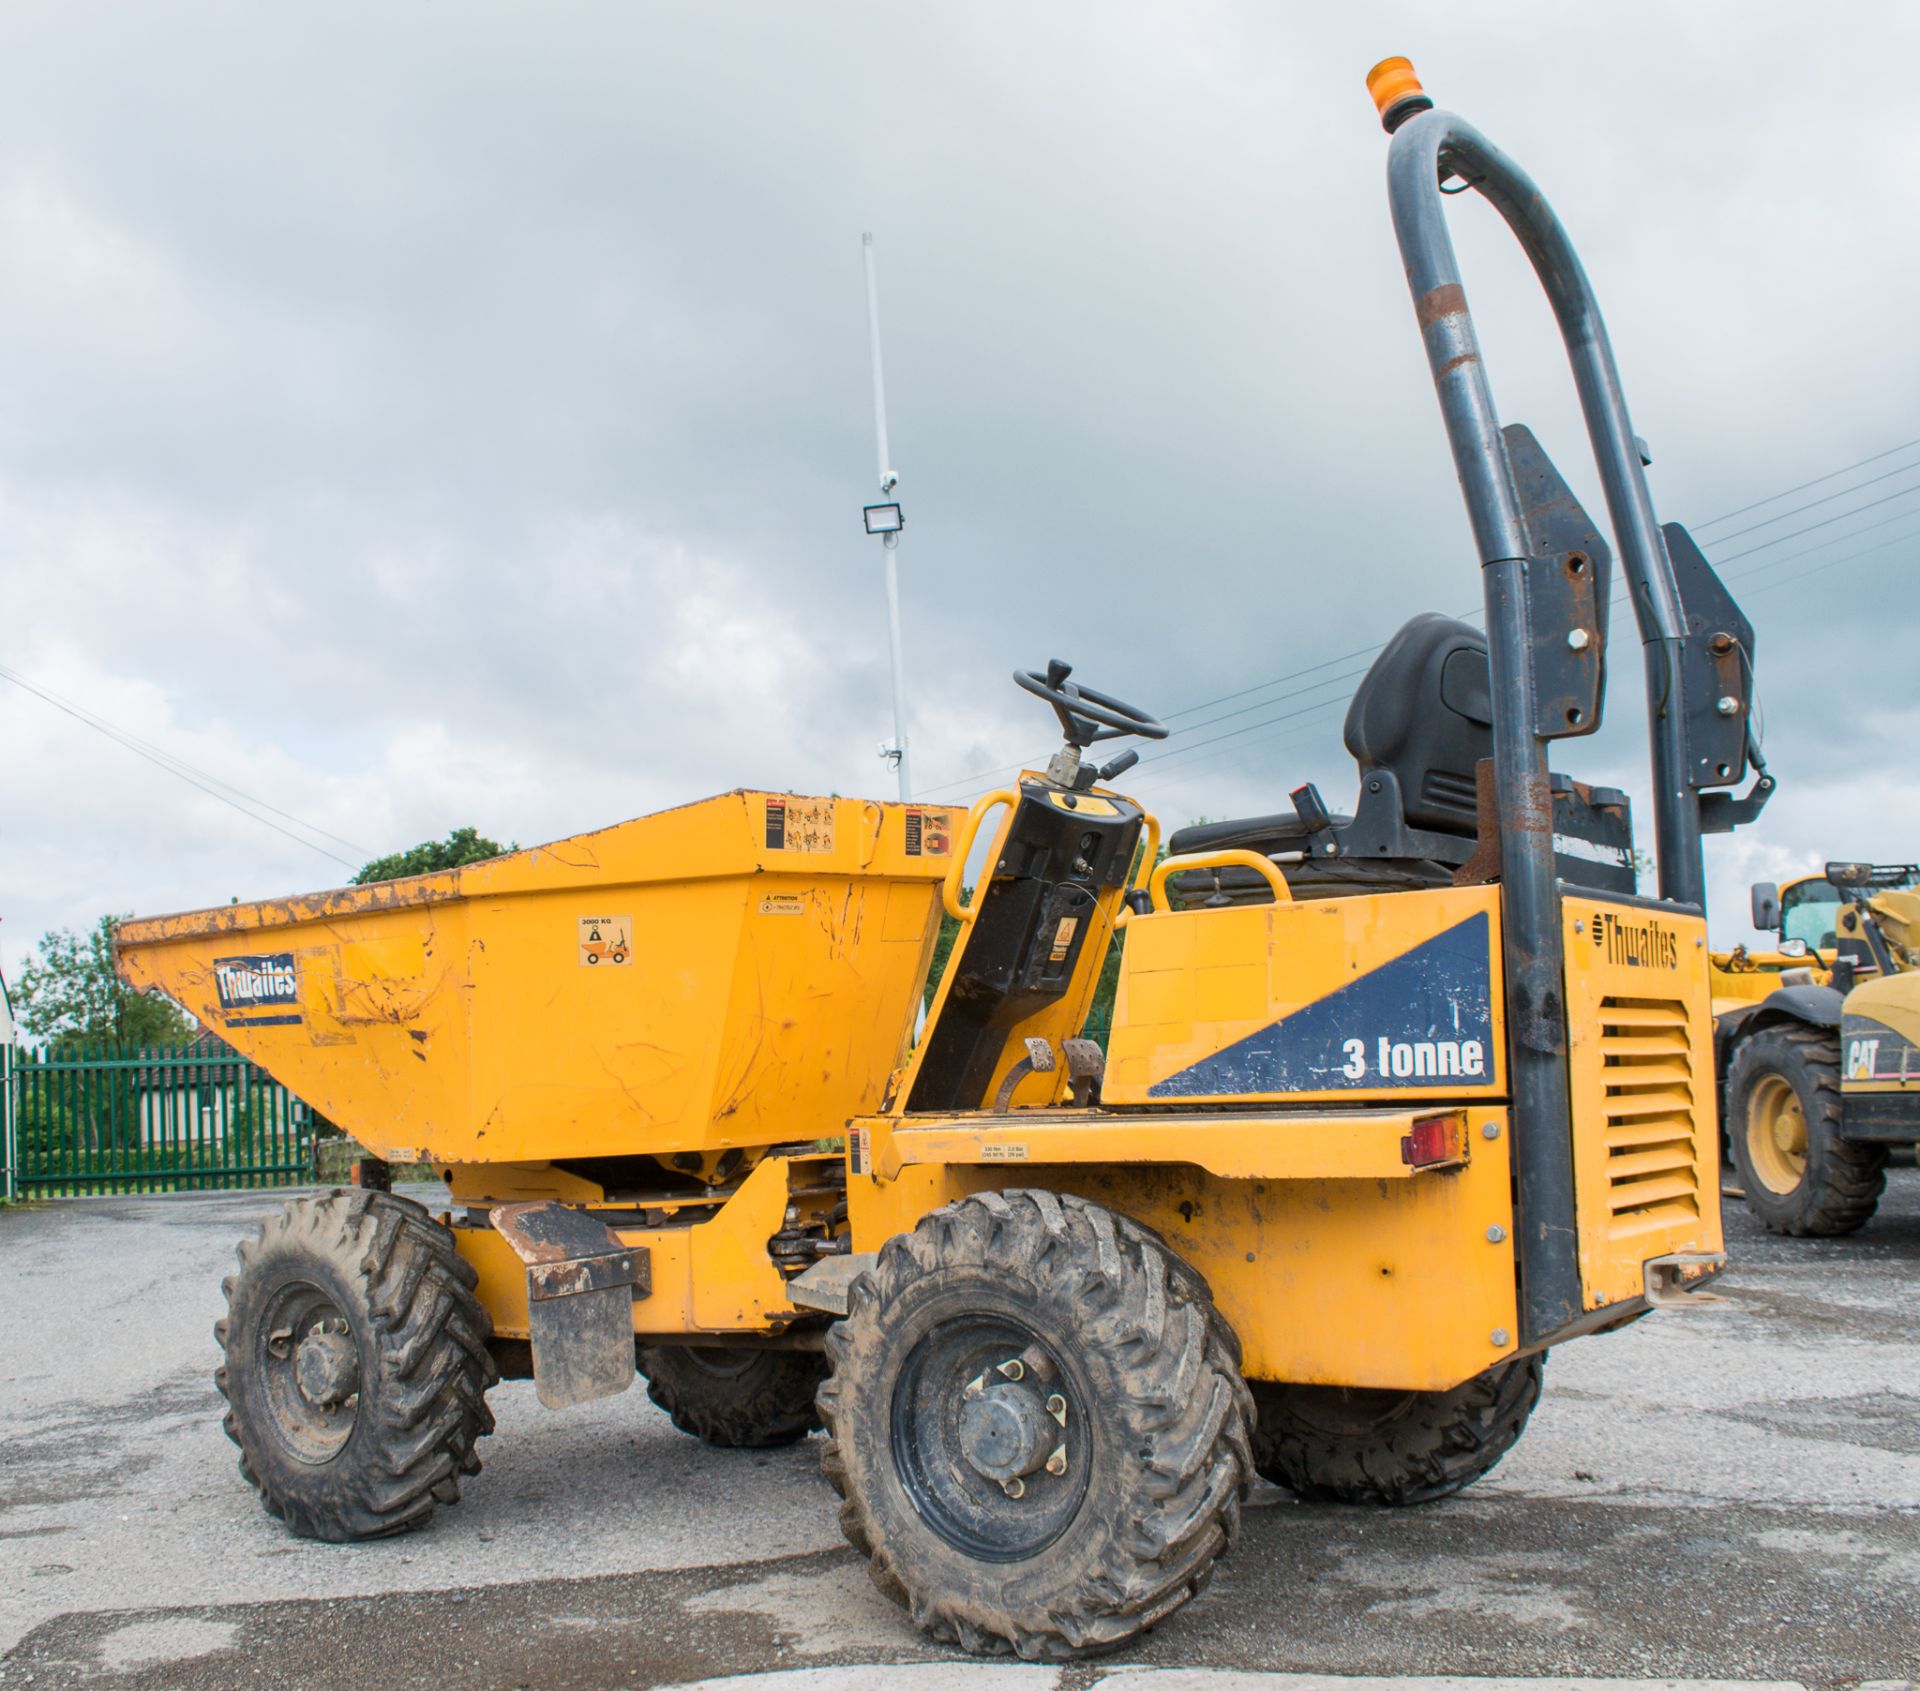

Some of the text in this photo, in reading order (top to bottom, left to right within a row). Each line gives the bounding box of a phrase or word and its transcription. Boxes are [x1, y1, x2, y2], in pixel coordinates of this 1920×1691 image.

[1604, 913, 1677, 971] Thwaites
[216, 961, 295, 1000] Thwaites
[1343, 1037, 1484, 1079] 3 tonne
[1848, 1039, 1880, 1080] CAT
